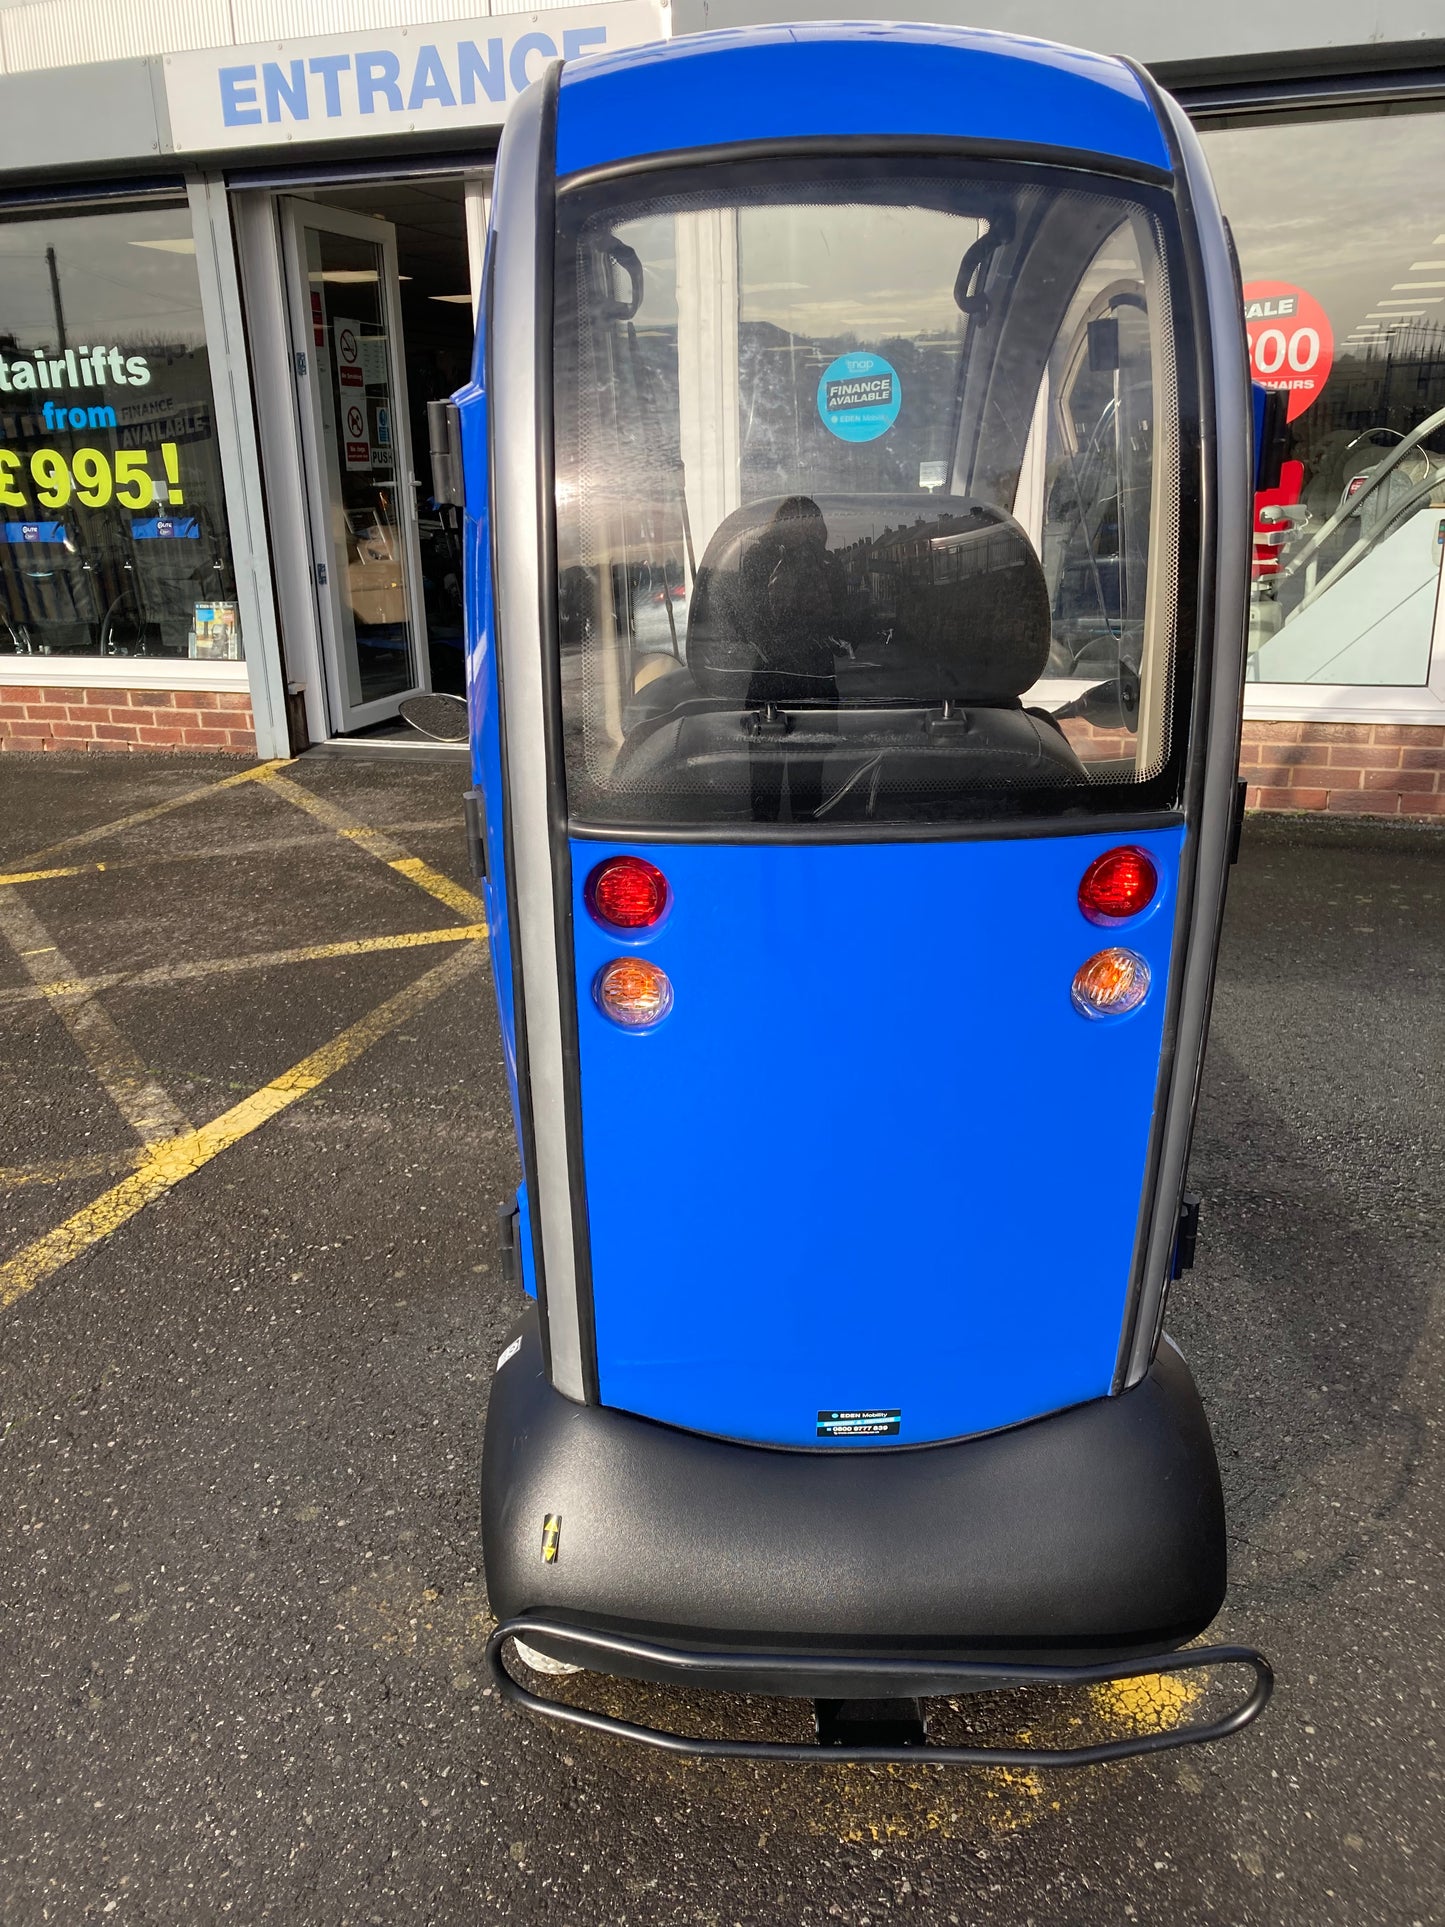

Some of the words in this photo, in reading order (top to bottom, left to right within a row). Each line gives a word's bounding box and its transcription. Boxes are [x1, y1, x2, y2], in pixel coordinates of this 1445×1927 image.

[1245, 299, 1294, 318] ALE
[1247, 327, 1320, 374] 00
[829, 391, 890, 406] AVAILABLE
[830, 379, 890, 397] FINANCE
[42, 401, 117, 430] from
[122, 398, 174, 421] FINANCE
[123, 413, 205, 447] AVAILABLE
[372, 451, 393, 464] PUSH
